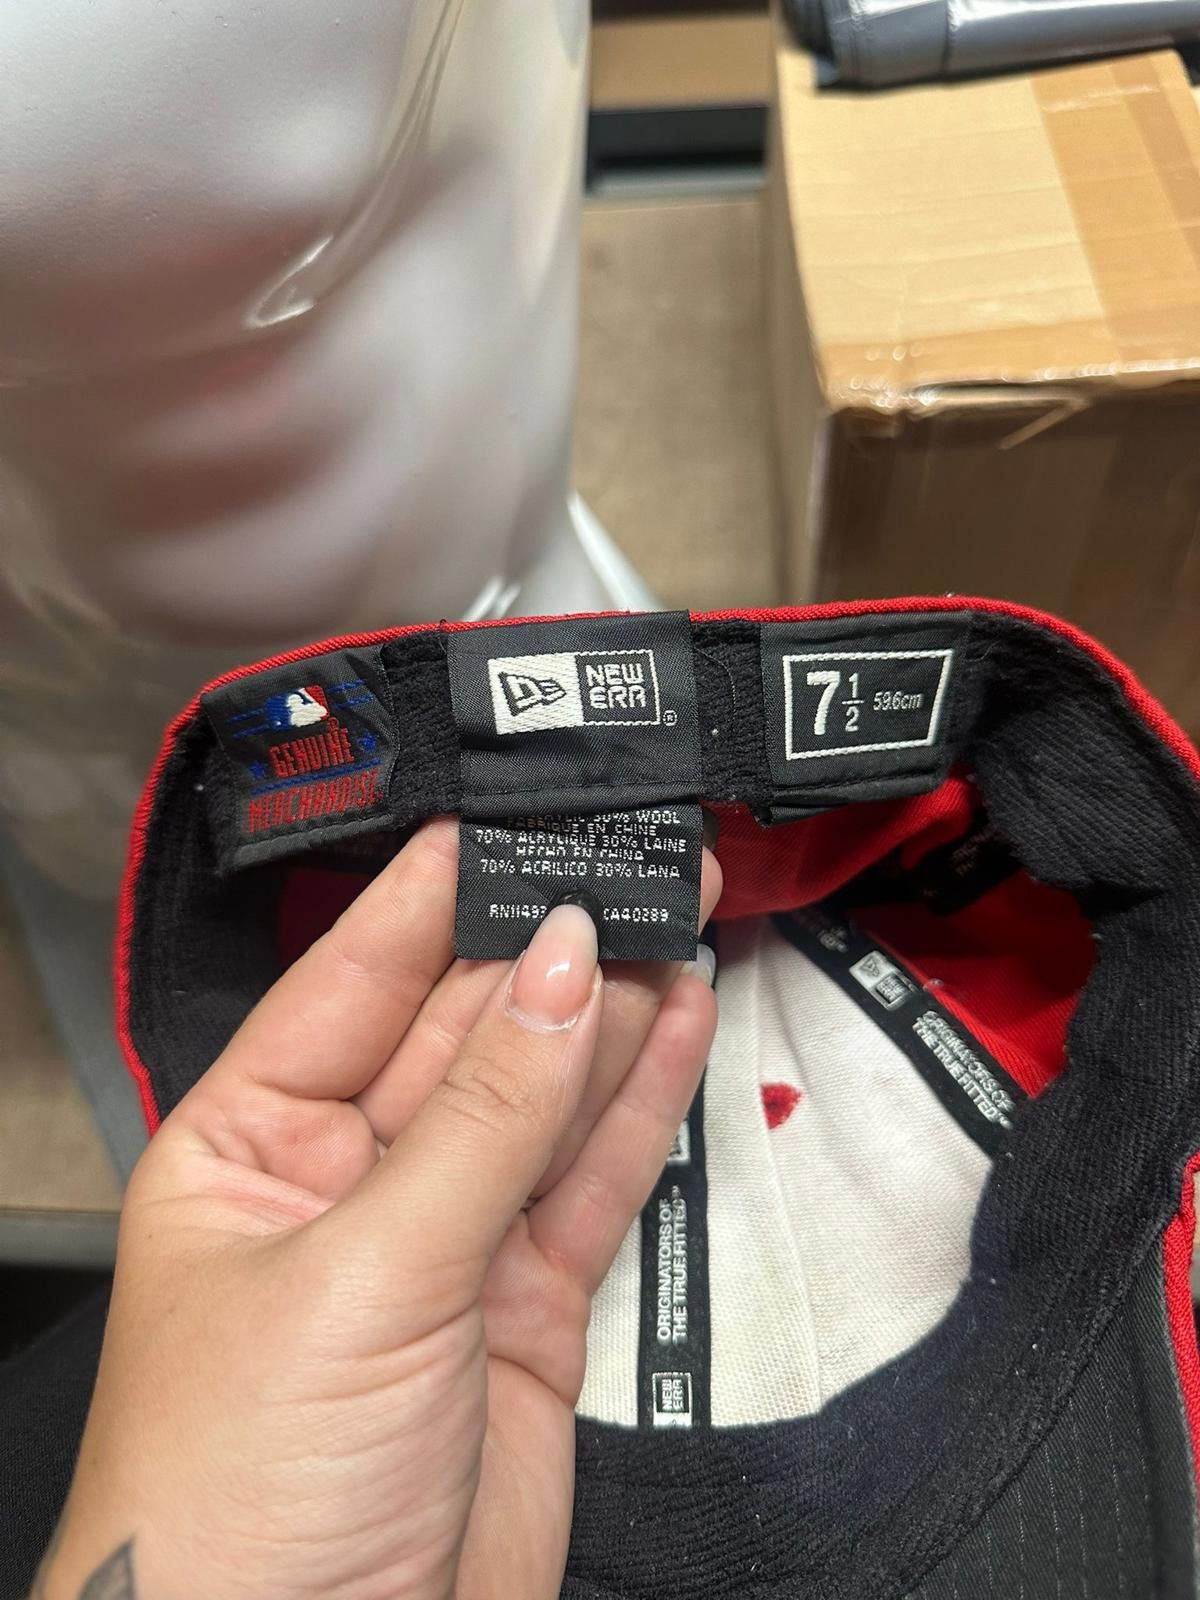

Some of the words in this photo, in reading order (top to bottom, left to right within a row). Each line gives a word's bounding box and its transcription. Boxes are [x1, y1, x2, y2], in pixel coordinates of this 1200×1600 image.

[585, 662, 645, 687] NEW
[589, 686, 646, 709] ERA
[806, 671, 840, 735] 7
[873, 692, 924, 711] 59.6cm
[268, 727, 355, 778] GENUINE
[247, 767, 379, 833] MERCHANDISE
[635, 810, 681, 824] WOOL
[476, 829, 513, 845] 70%
[601, 835, 639, 849] 30%
[644, 838, 687, 853] LAINE
[587, 823, 606, 834] EN
[615, 824, 657, 836] CHINE
[480, 858, 516, 875] 70%
[521, 860, 588, 877] ACRILICO
[594, 862, 633, 878] 30%
[637, 864, 681, 879] LANA
[932, 1040, 969, 1081] TRUE
[658, 1197, 673, 1223] OF
[657, 1223, 673, 1345] ORIGINATORS
[672, 1256, 688, 1305] TRUE
[672, 1305, 689, 1345] THE
[661, 1378, 673, 1412] NEW
[672, 1378, 684, 1412] ERA
